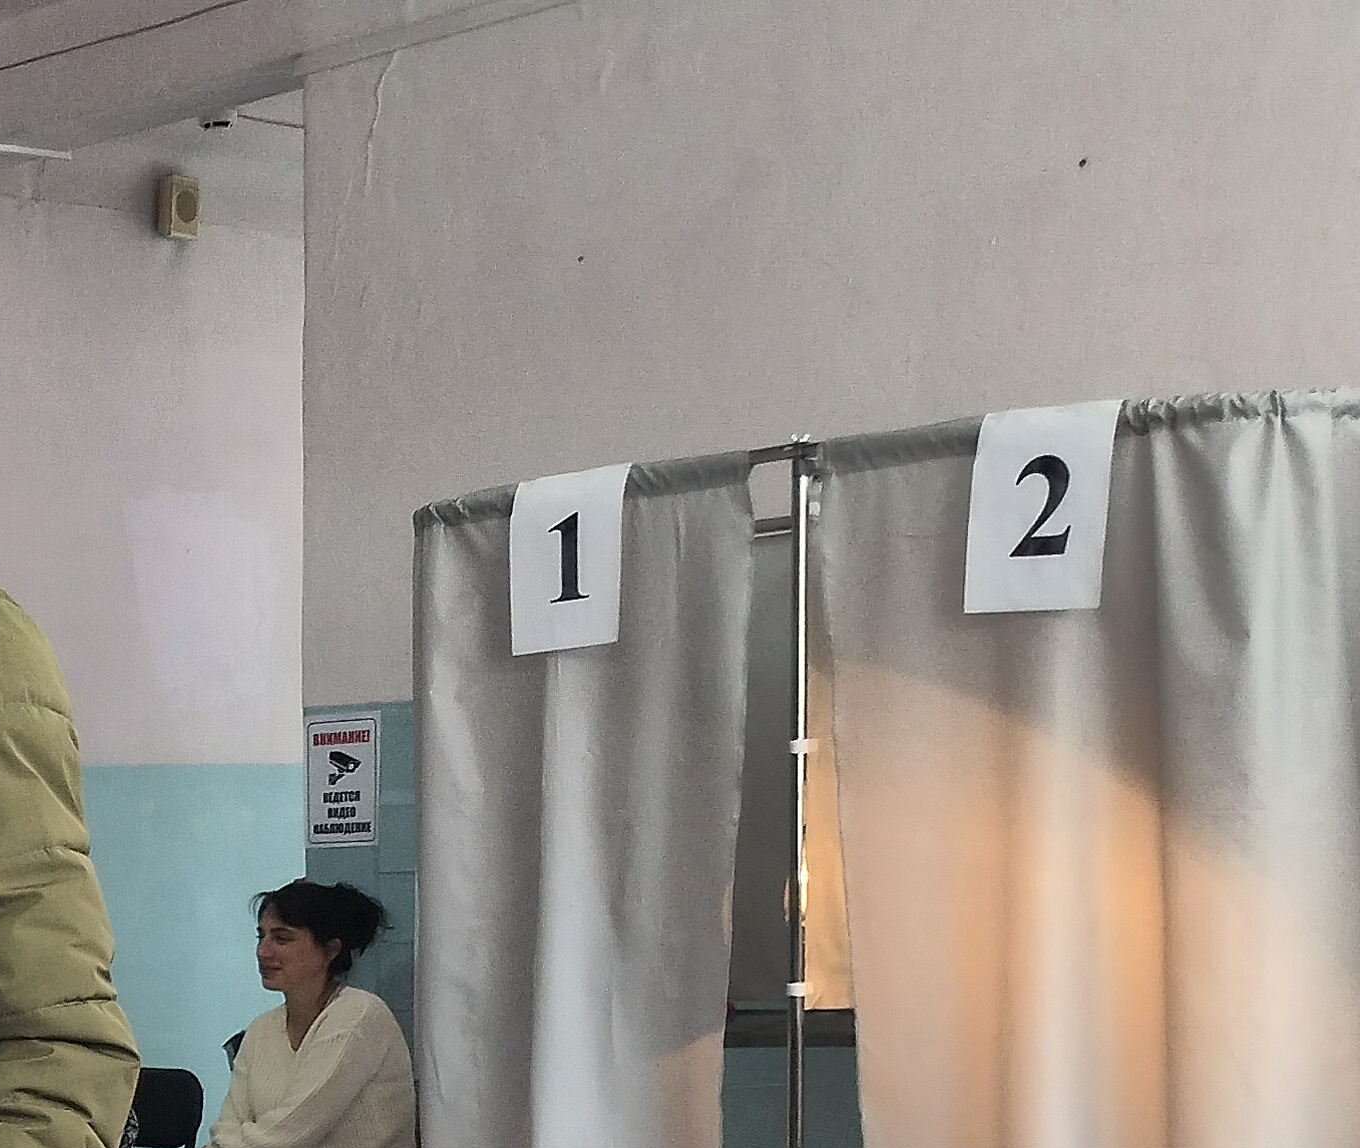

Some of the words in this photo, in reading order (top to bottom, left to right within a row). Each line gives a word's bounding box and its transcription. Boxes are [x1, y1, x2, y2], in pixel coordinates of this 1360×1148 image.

[1008, 454, 1072, 558] 2
[547, 511, 590, 604] 1
[323, 790, 361, 804] ВЕДЕТСЯ
[327, 806, 357, 819] ВИДЕО
[313, 821, 372, 835] НАБЛЮДЕНИЕ
